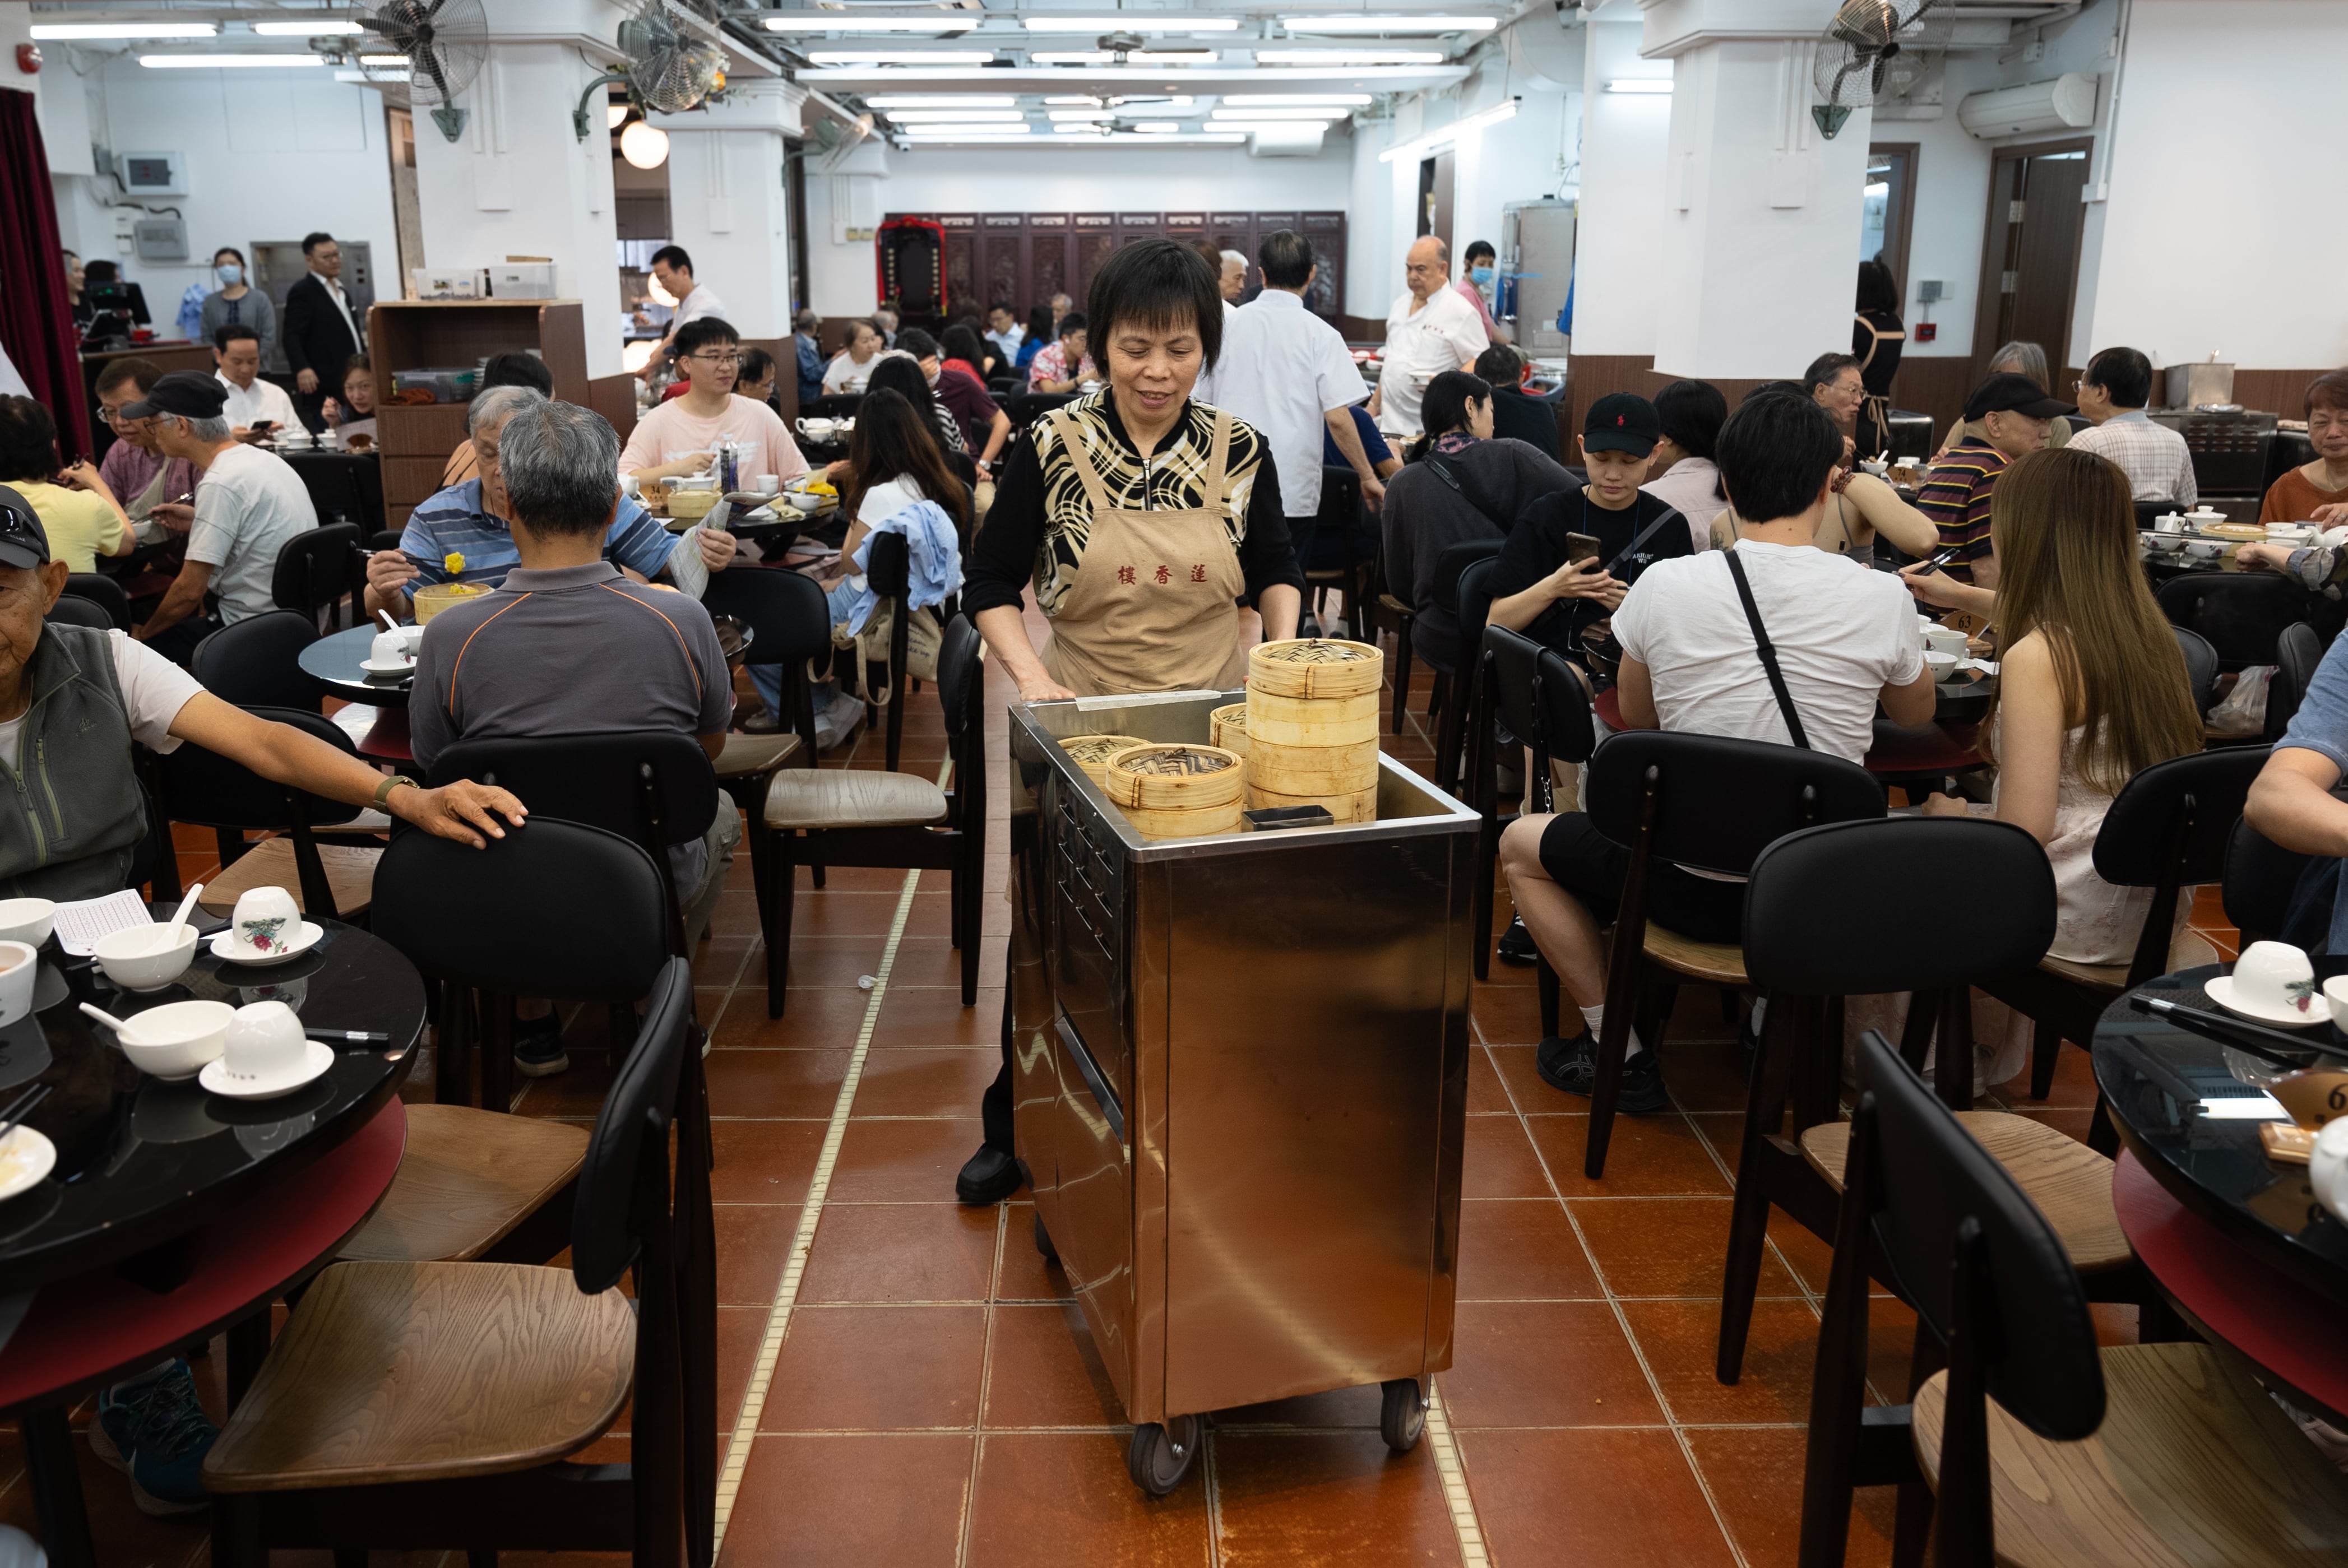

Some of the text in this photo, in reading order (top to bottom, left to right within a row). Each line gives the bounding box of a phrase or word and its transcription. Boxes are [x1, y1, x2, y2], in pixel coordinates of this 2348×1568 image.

[1897, 468, 1906, 477] 74
[651, 485, 660, 494] 34
[1958, 615, 1971, 629] 63
